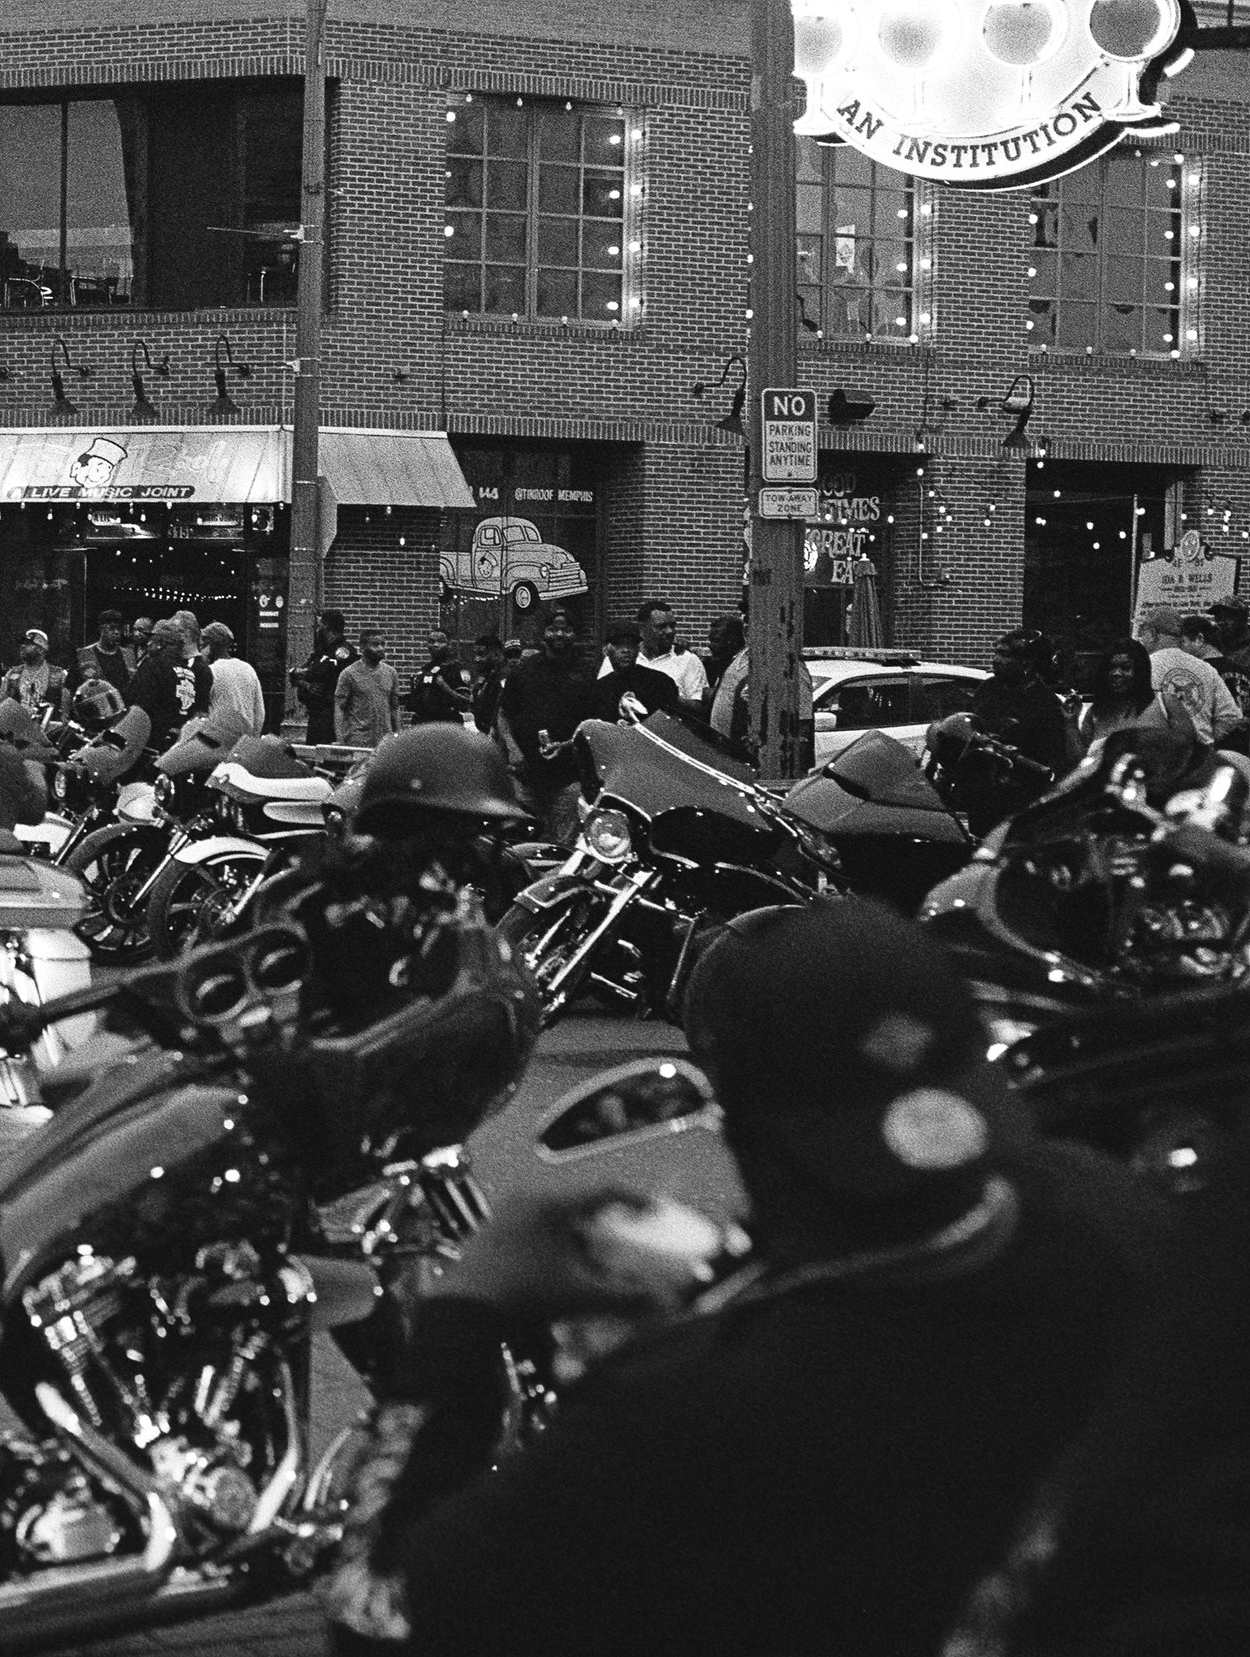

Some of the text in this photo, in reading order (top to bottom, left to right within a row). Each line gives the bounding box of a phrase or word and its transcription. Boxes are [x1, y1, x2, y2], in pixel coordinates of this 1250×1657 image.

[836, 91, 1101, 168] AN INSTITUTION
[773, 396, 806, 416] NO
[768, 424, 812, 437] PARKING
[768, 441, 812, 454] STANDING
[768, 455, 812, 467] ANYTIME
[30, 487, 72, 499] LIVE
[77, 486, 134, 499] MUSIC
[140, 486, 191, 499] JOINT
[777, 504, 803, 513] ZONE
[824, 496, 880, 521] TIMES
[807, 529, 866, 558] GREAT
